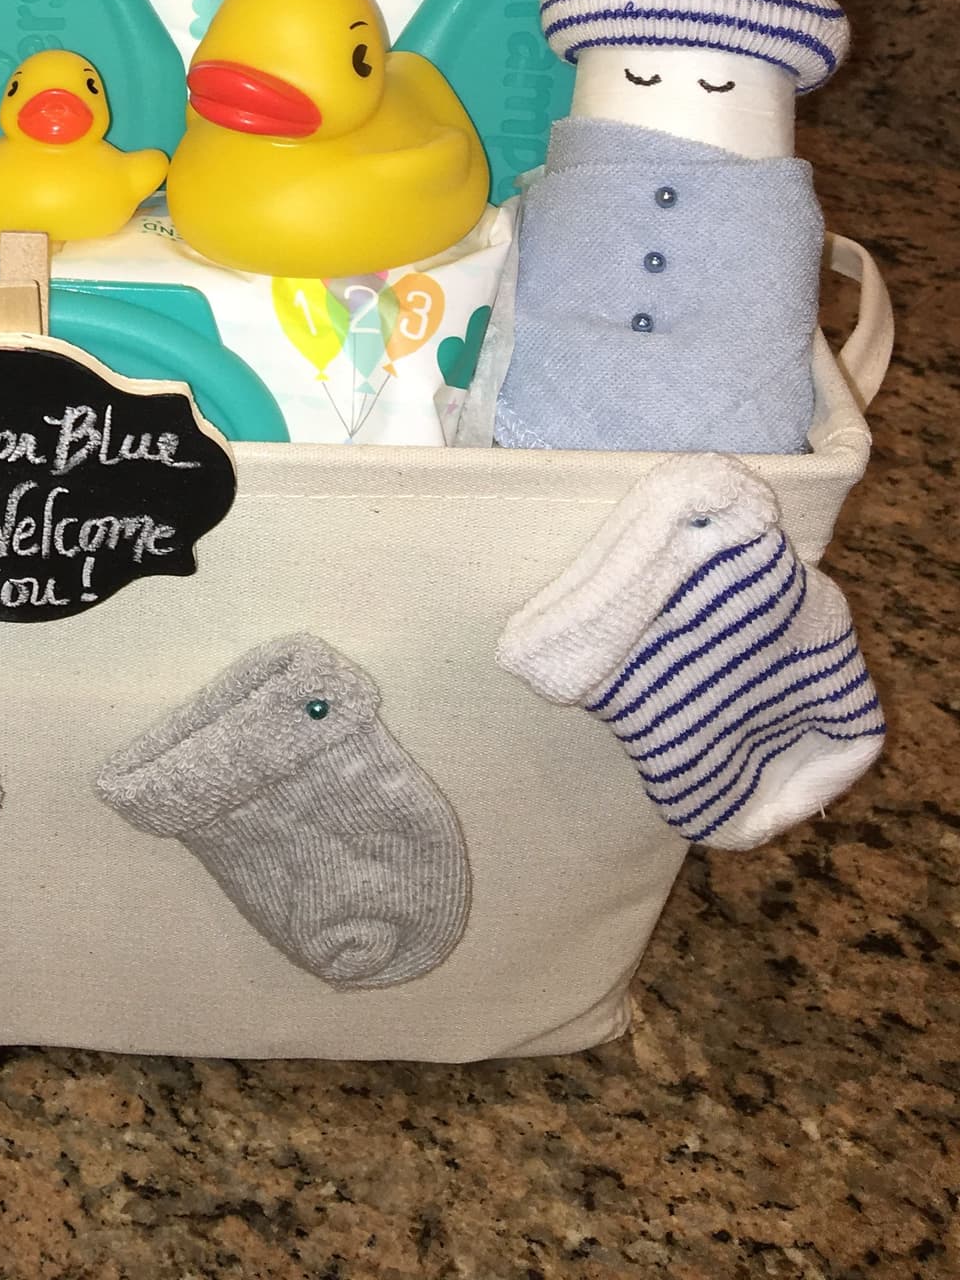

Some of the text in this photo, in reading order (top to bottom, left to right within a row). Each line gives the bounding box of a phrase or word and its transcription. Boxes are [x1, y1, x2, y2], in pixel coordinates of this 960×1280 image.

[293, 284, 433, 340] 1 2 3
[43, 404, 201, 475] Blue
